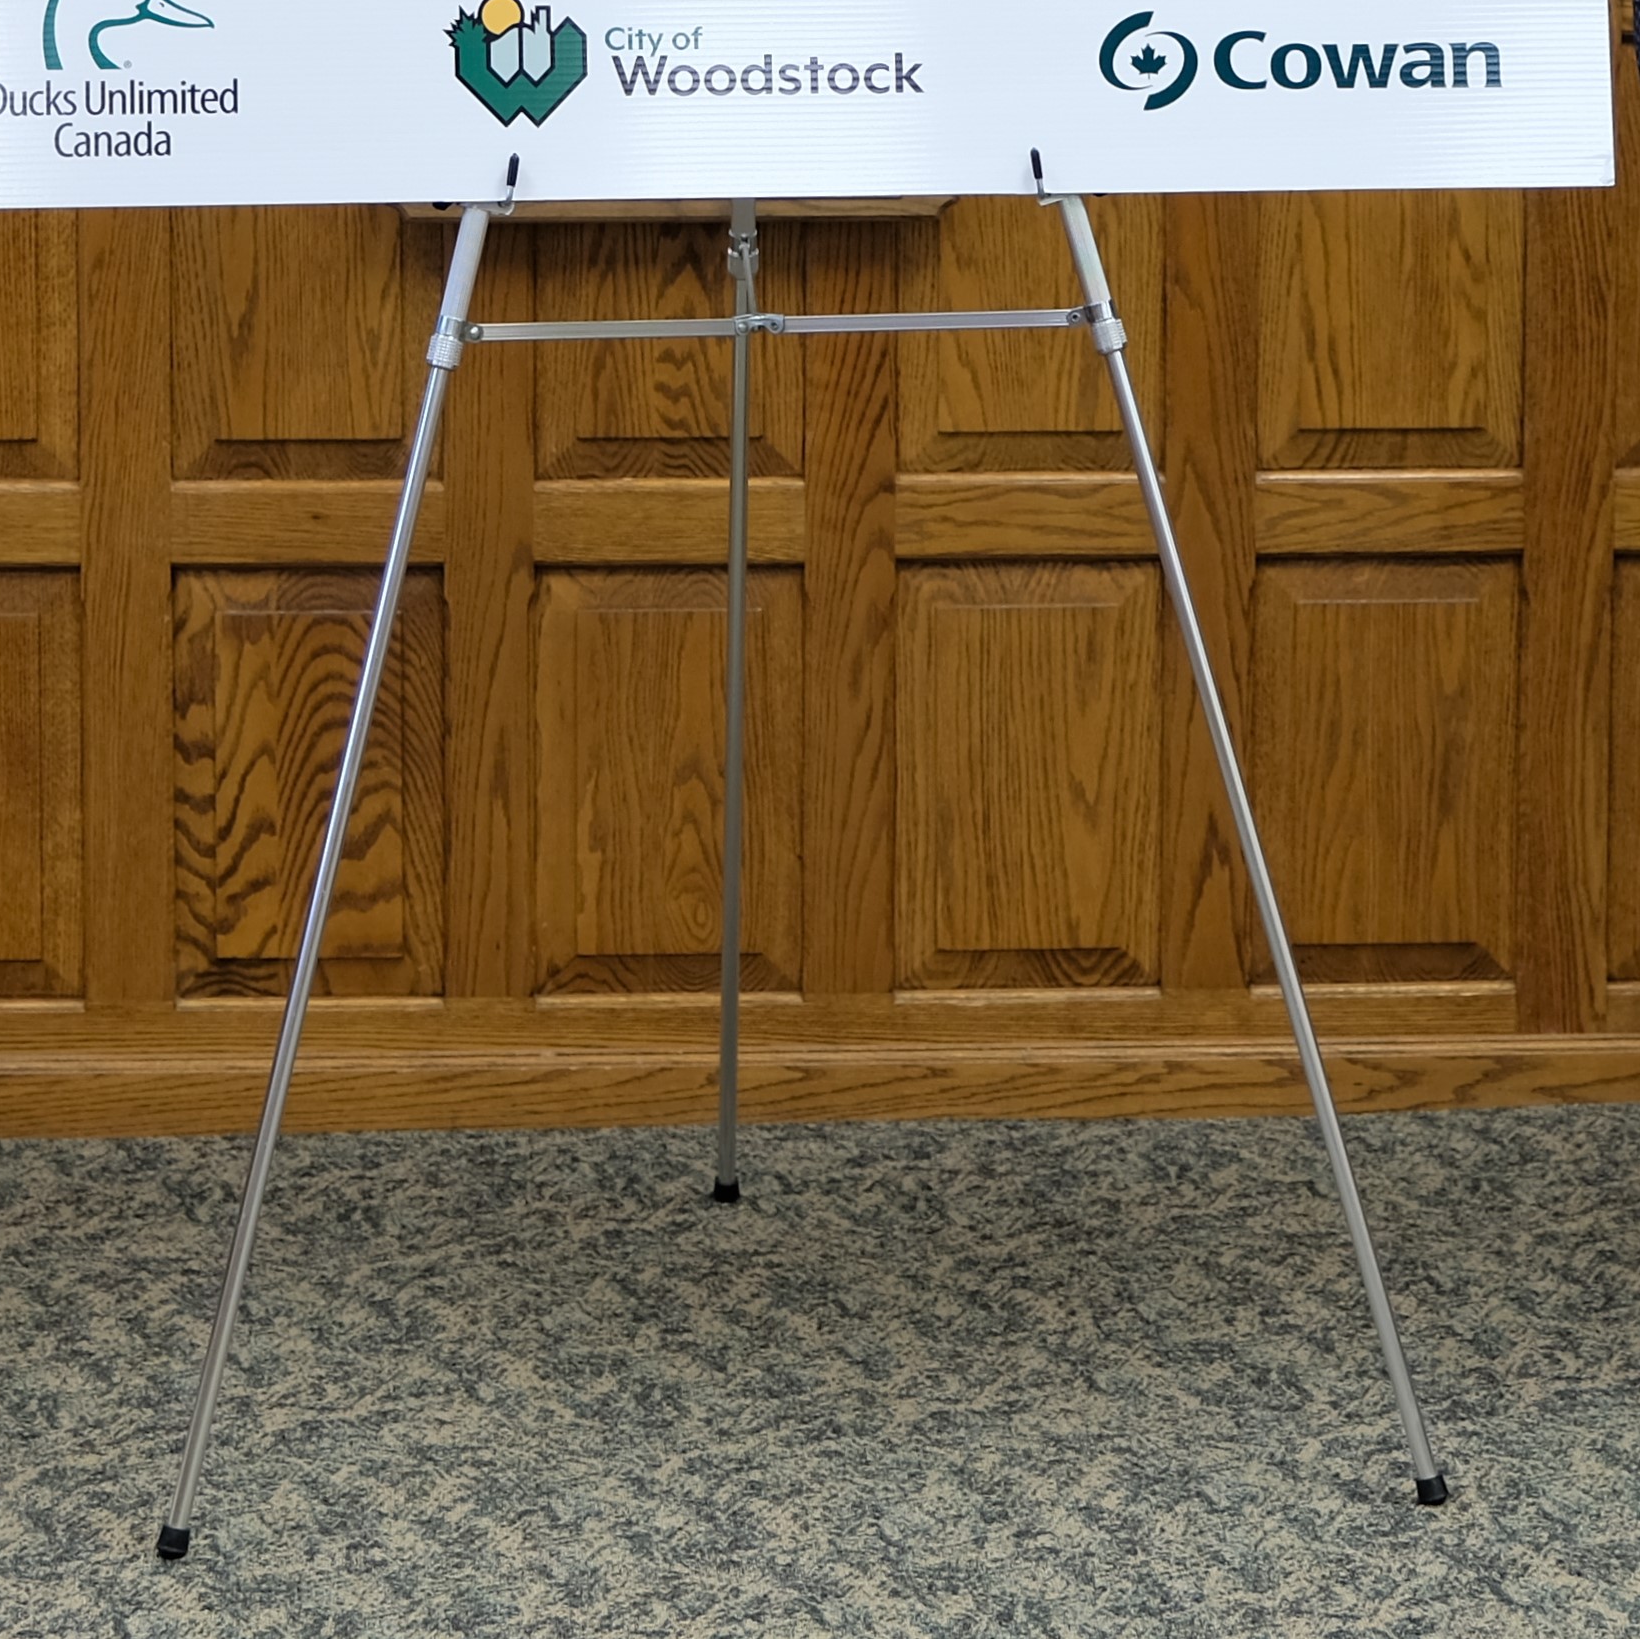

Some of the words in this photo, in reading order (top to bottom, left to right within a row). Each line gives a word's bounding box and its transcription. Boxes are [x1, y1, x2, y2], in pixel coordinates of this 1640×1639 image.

[604, 27, 663, 60] City
[672, 26, 702, 51] of
[1214, 31, 1502, 90] Cowan
[612, 51, 925, 96] Woodstock
[85, 78, 239, 116] Unlimited
[54, 120, 172, 158] Canada
